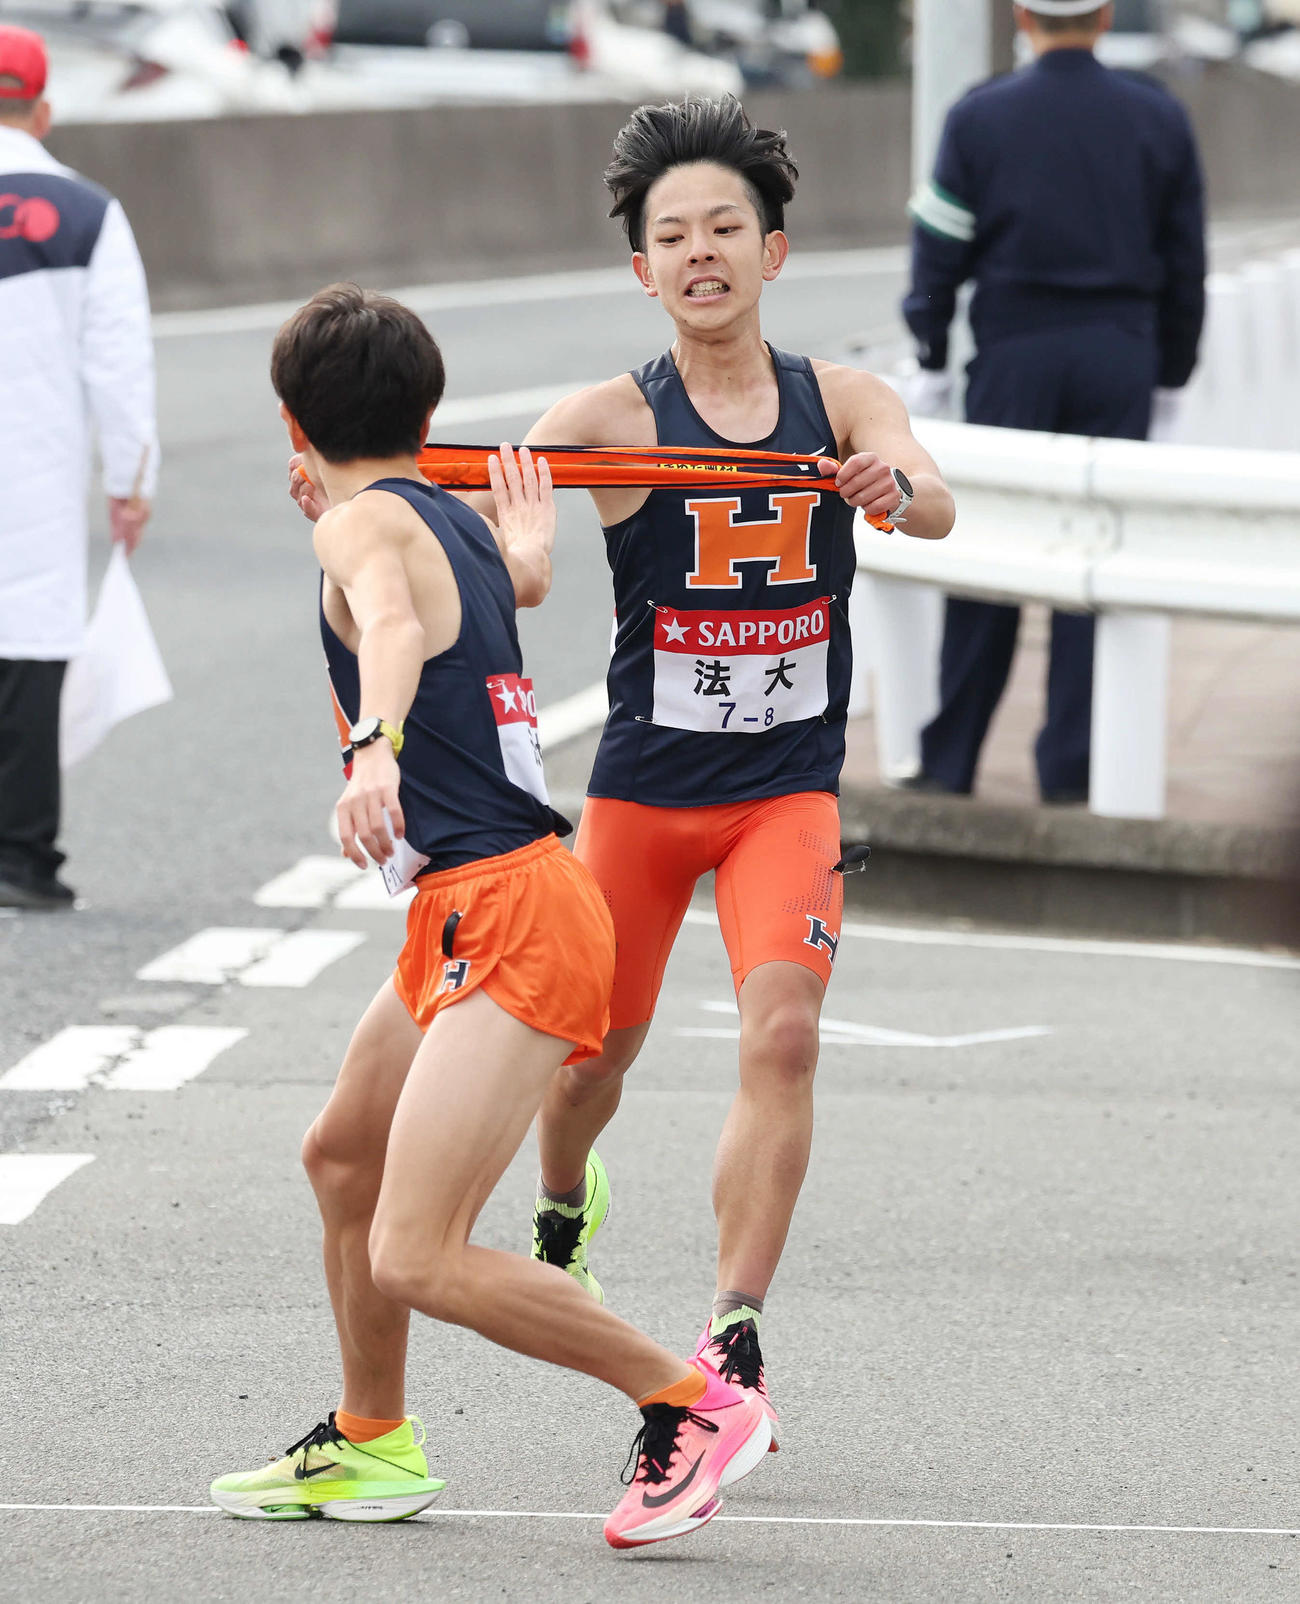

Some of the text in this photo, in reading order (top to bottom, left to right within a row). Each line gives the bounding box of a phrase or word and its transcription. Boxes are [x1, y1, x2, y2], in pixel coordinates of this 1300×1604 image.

[685, 491, 821, 589] H
[697, 609, 824, 647] SAPPORO
[435, 958, 472, 994] H
